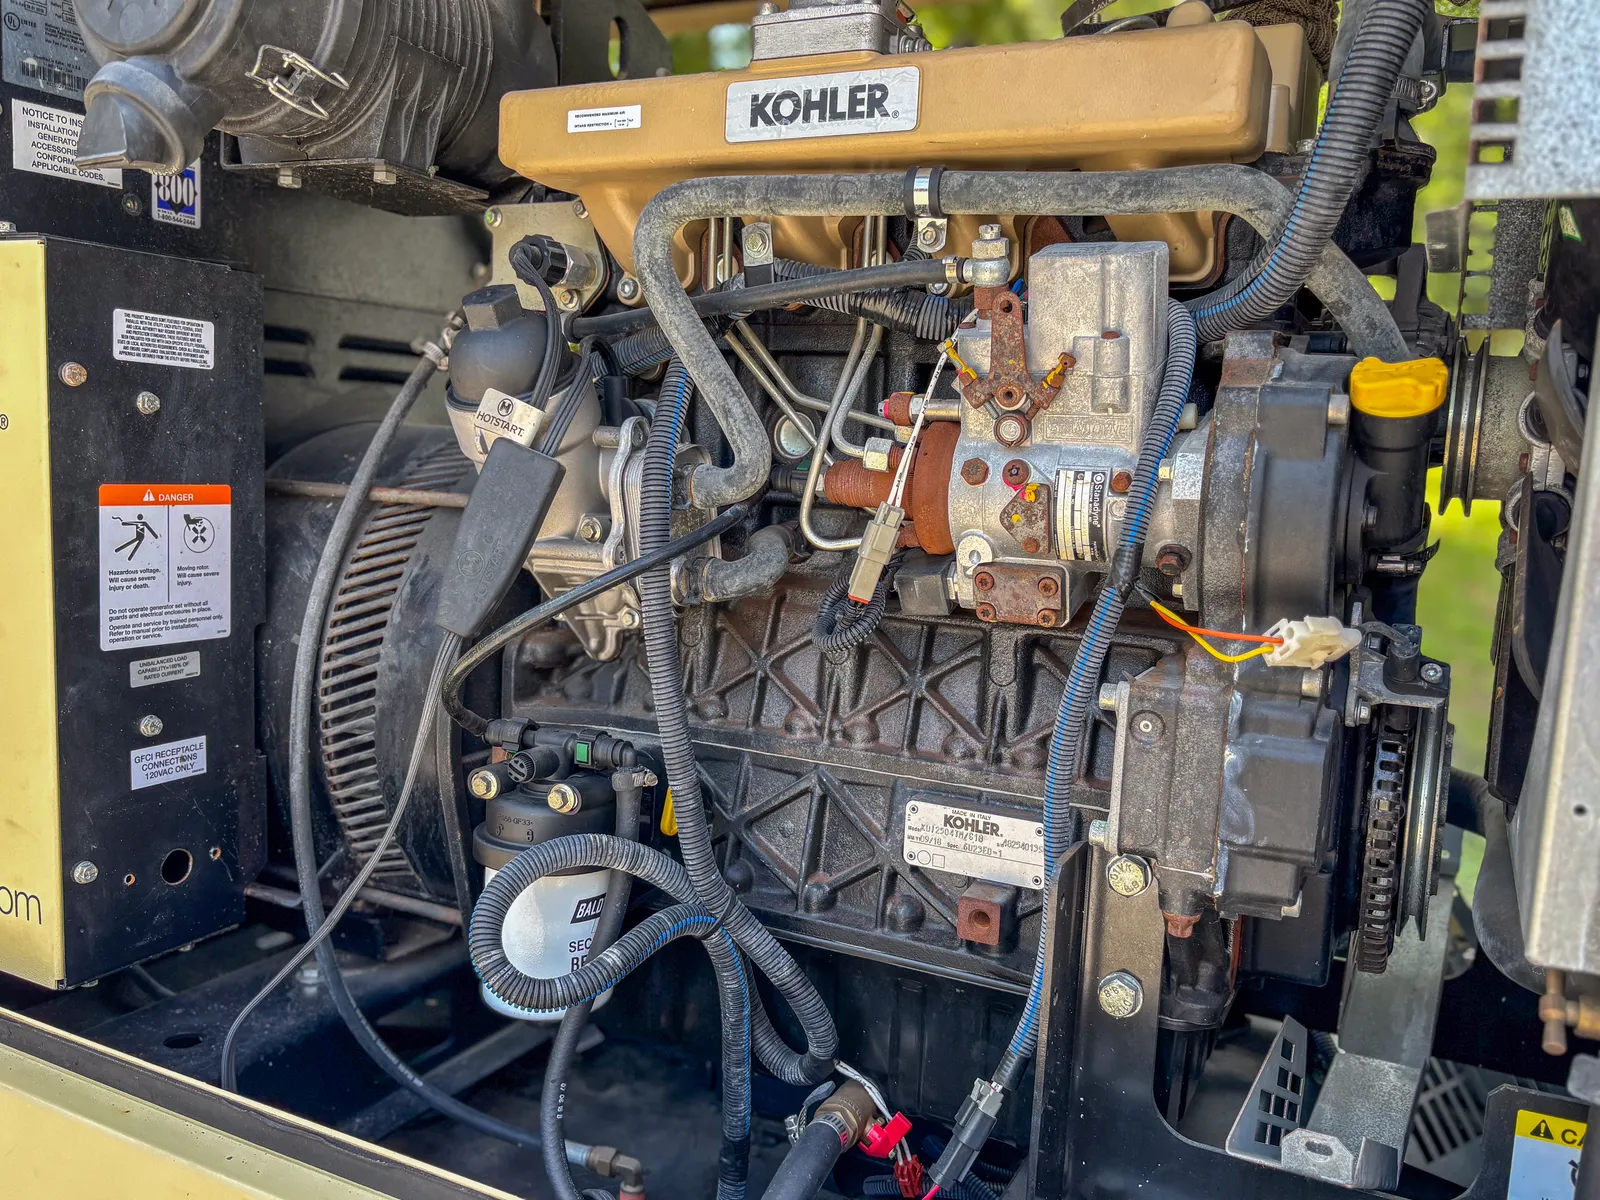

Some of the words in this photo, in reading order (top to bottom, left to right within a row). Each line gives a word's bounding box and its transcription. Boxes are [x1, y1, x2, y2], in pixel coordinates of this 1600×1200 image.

[22, 107, 54, 121] NOTICE
[56, 115, 67, 124] TO
[28, 120, 78, 137] INSTALLATION
[32, 160, 77, 175] APPLICABLE
[78, 170, 105, 181] CODES.
[159, 174, 194, 206] 800
[159, 494, 194, 502] DANGER
[128, 606, 148, 614] operate
[150, 604, 174, 612] generator
[140, 610, 163, 618] electrical
[164, 608, 191, 616] enclosures
[188, 615, 211, 623] personnel
[140, 658, 173, 668] UNBALANCED
[161, 669, 184, 677] CURRENT
[134, 754, 153, 763] GFCI
[155, 742, 204, 758] RECEPTACLE
[142, 753, 197, 772] CONNECTIONS
[145, 768, 173, 780] 120VAC
[175, 762, 195, 774] ONLY
